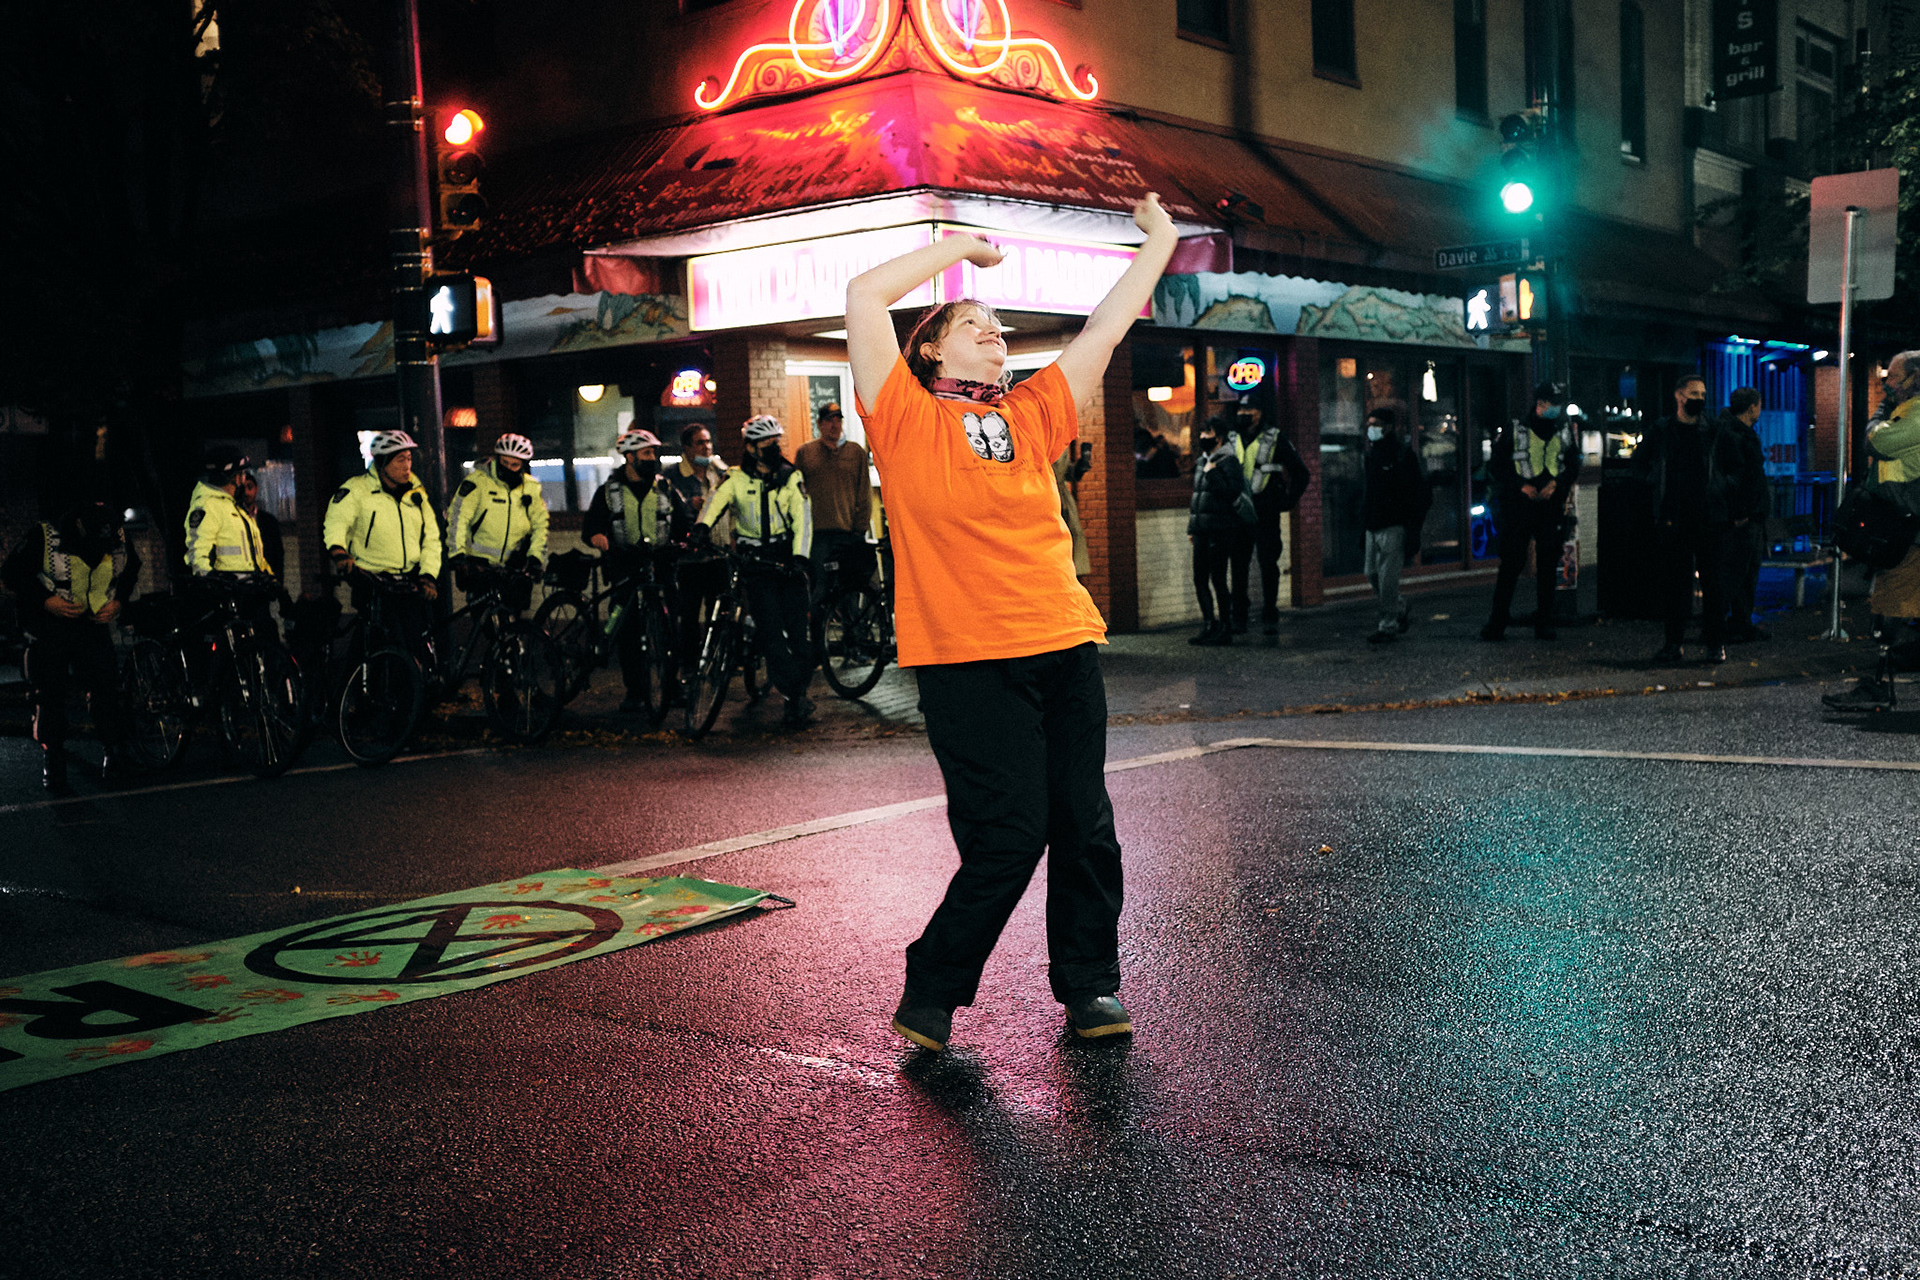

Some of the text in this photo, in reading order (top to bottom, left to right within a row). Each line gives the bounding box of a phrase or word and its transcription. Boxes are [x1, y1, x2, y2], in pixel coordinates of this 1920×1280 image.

[1728, 41, 1764, 56] bar
[1726, 65, 1766, 88] grill
[1438, 248, 1478, 267] Davie
[1229, 363, 1262, 384] OPEN
